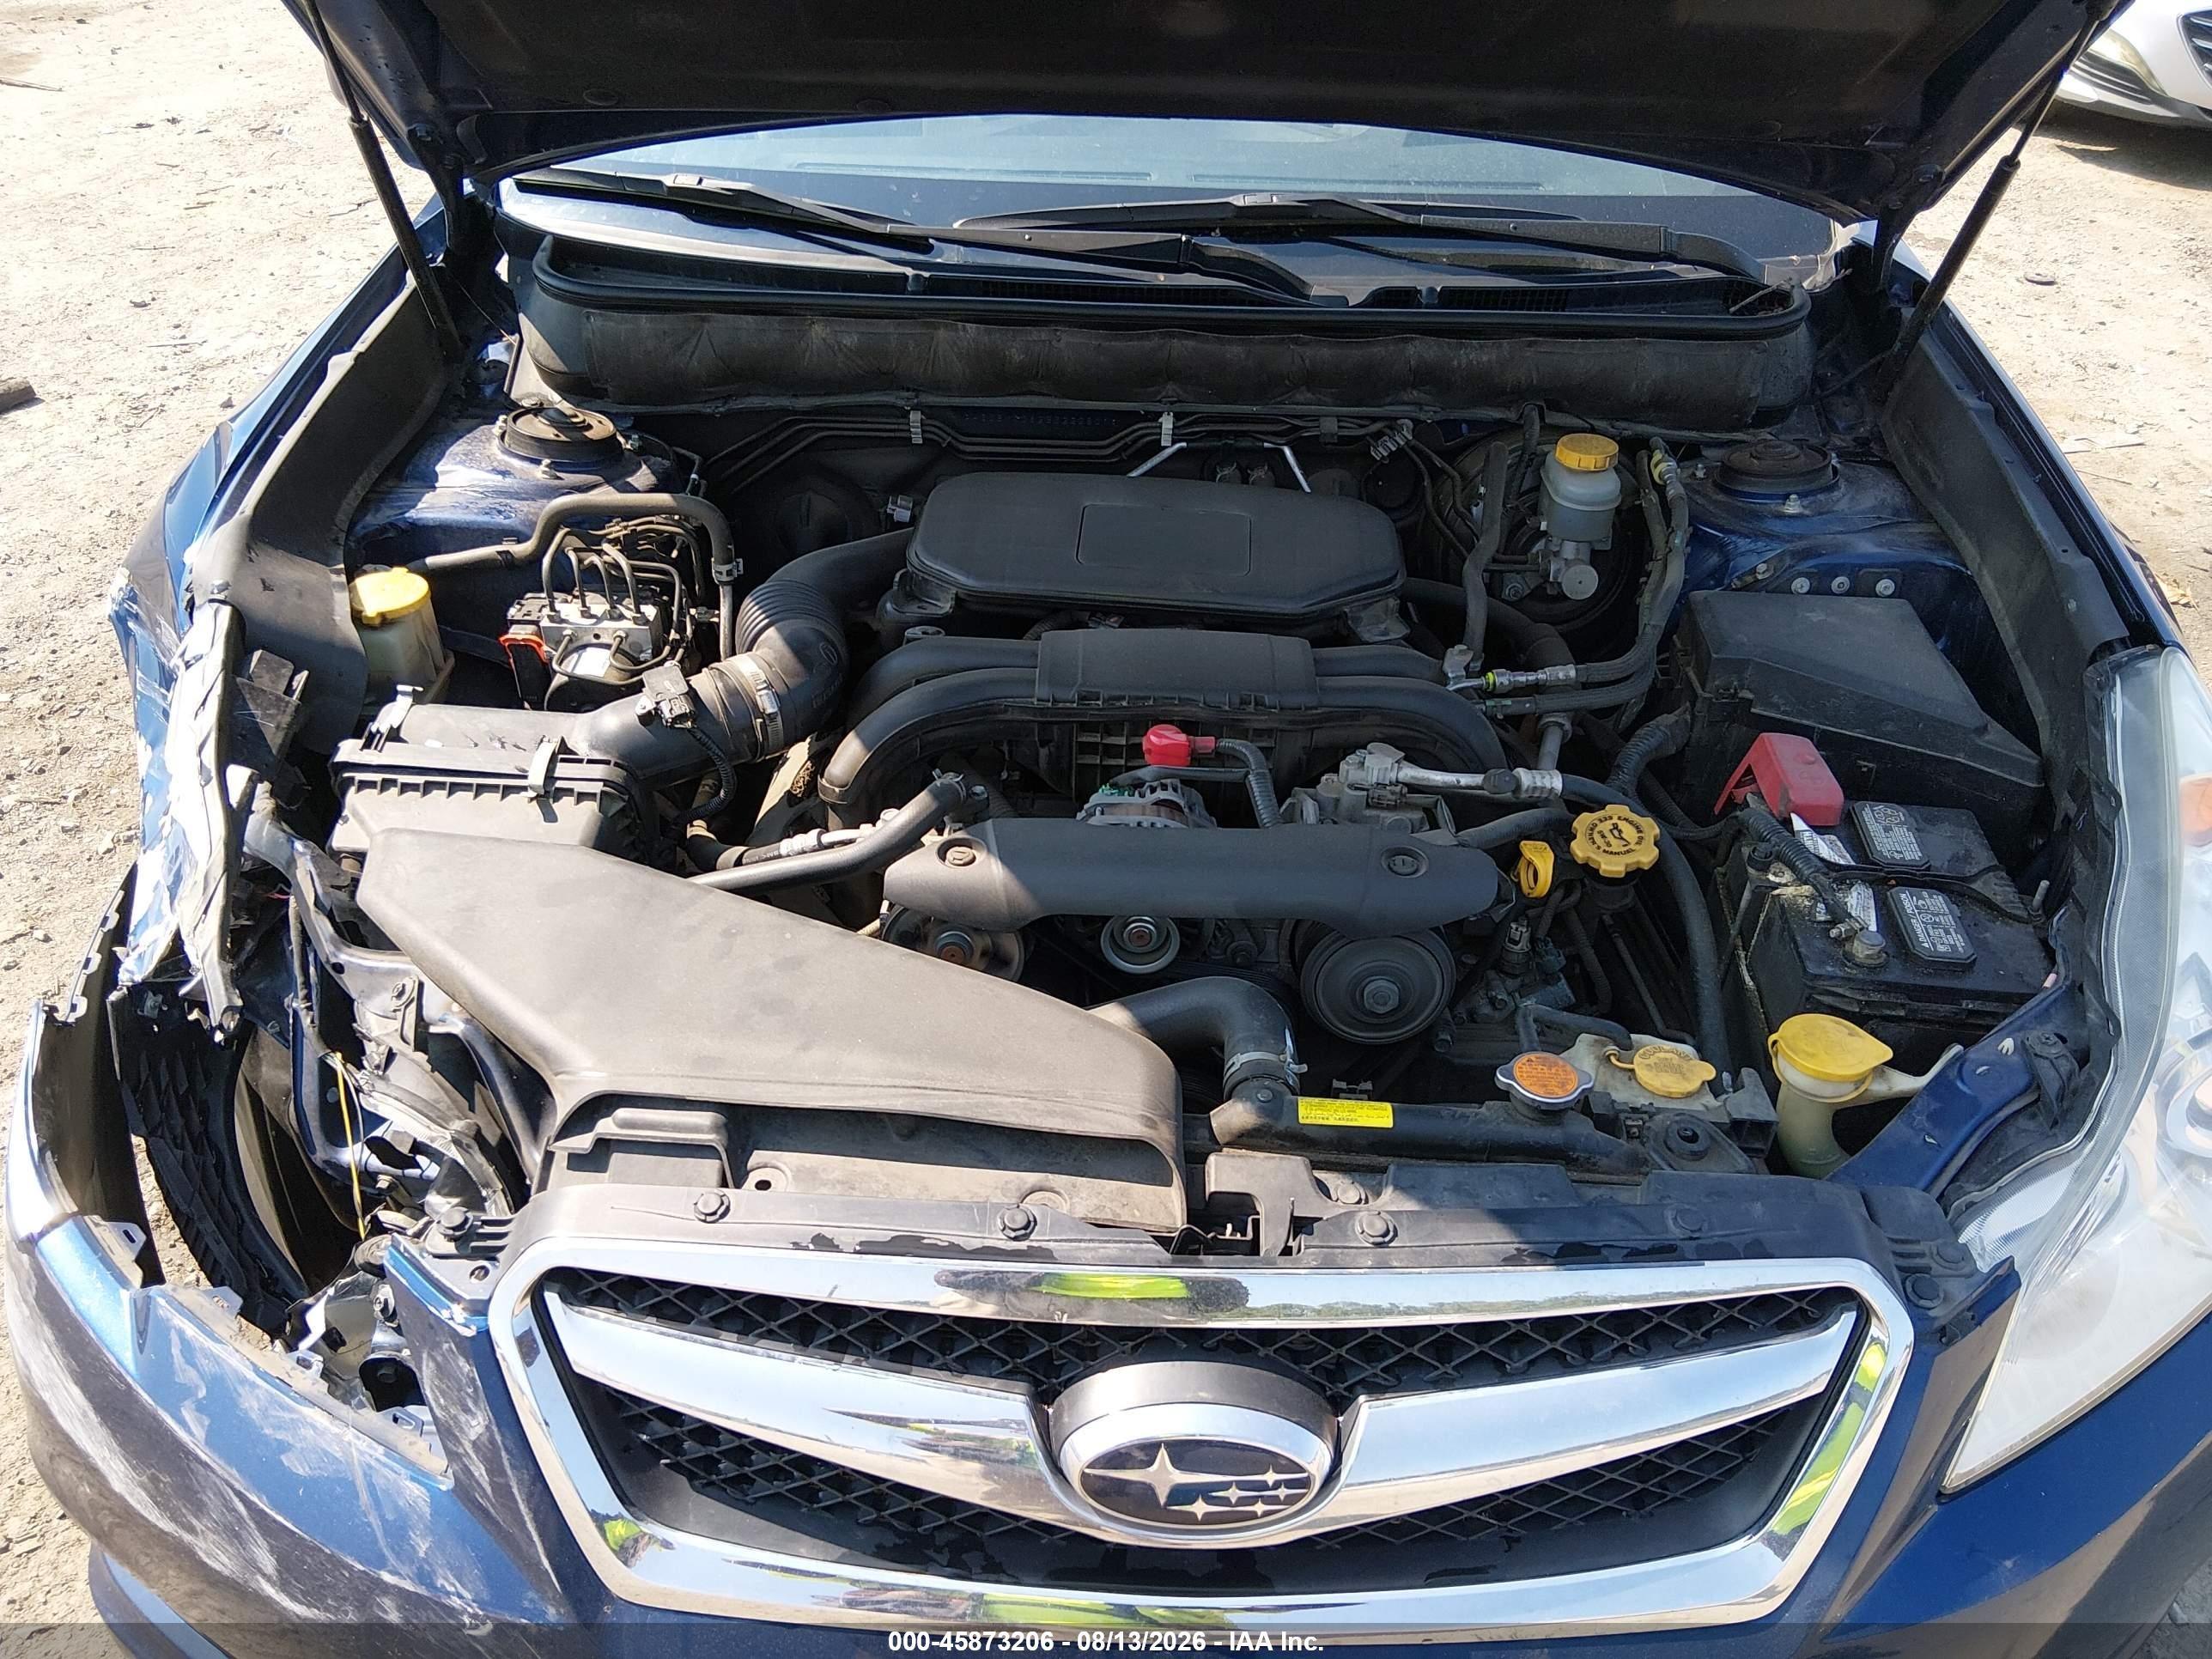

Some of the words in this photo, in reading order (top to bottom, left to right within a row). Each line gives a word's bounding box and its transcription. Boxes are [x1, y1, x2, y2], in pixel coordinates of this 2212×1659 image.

[1617, 815, 1644, 835] ENGINE
[1635, 836, 1644, 846] OIL
[1602, 848, 1636, 856] MANUAL
[1899, 893, 1915, 914] POISON
[1910, 919, 1927, 943] DANGER
